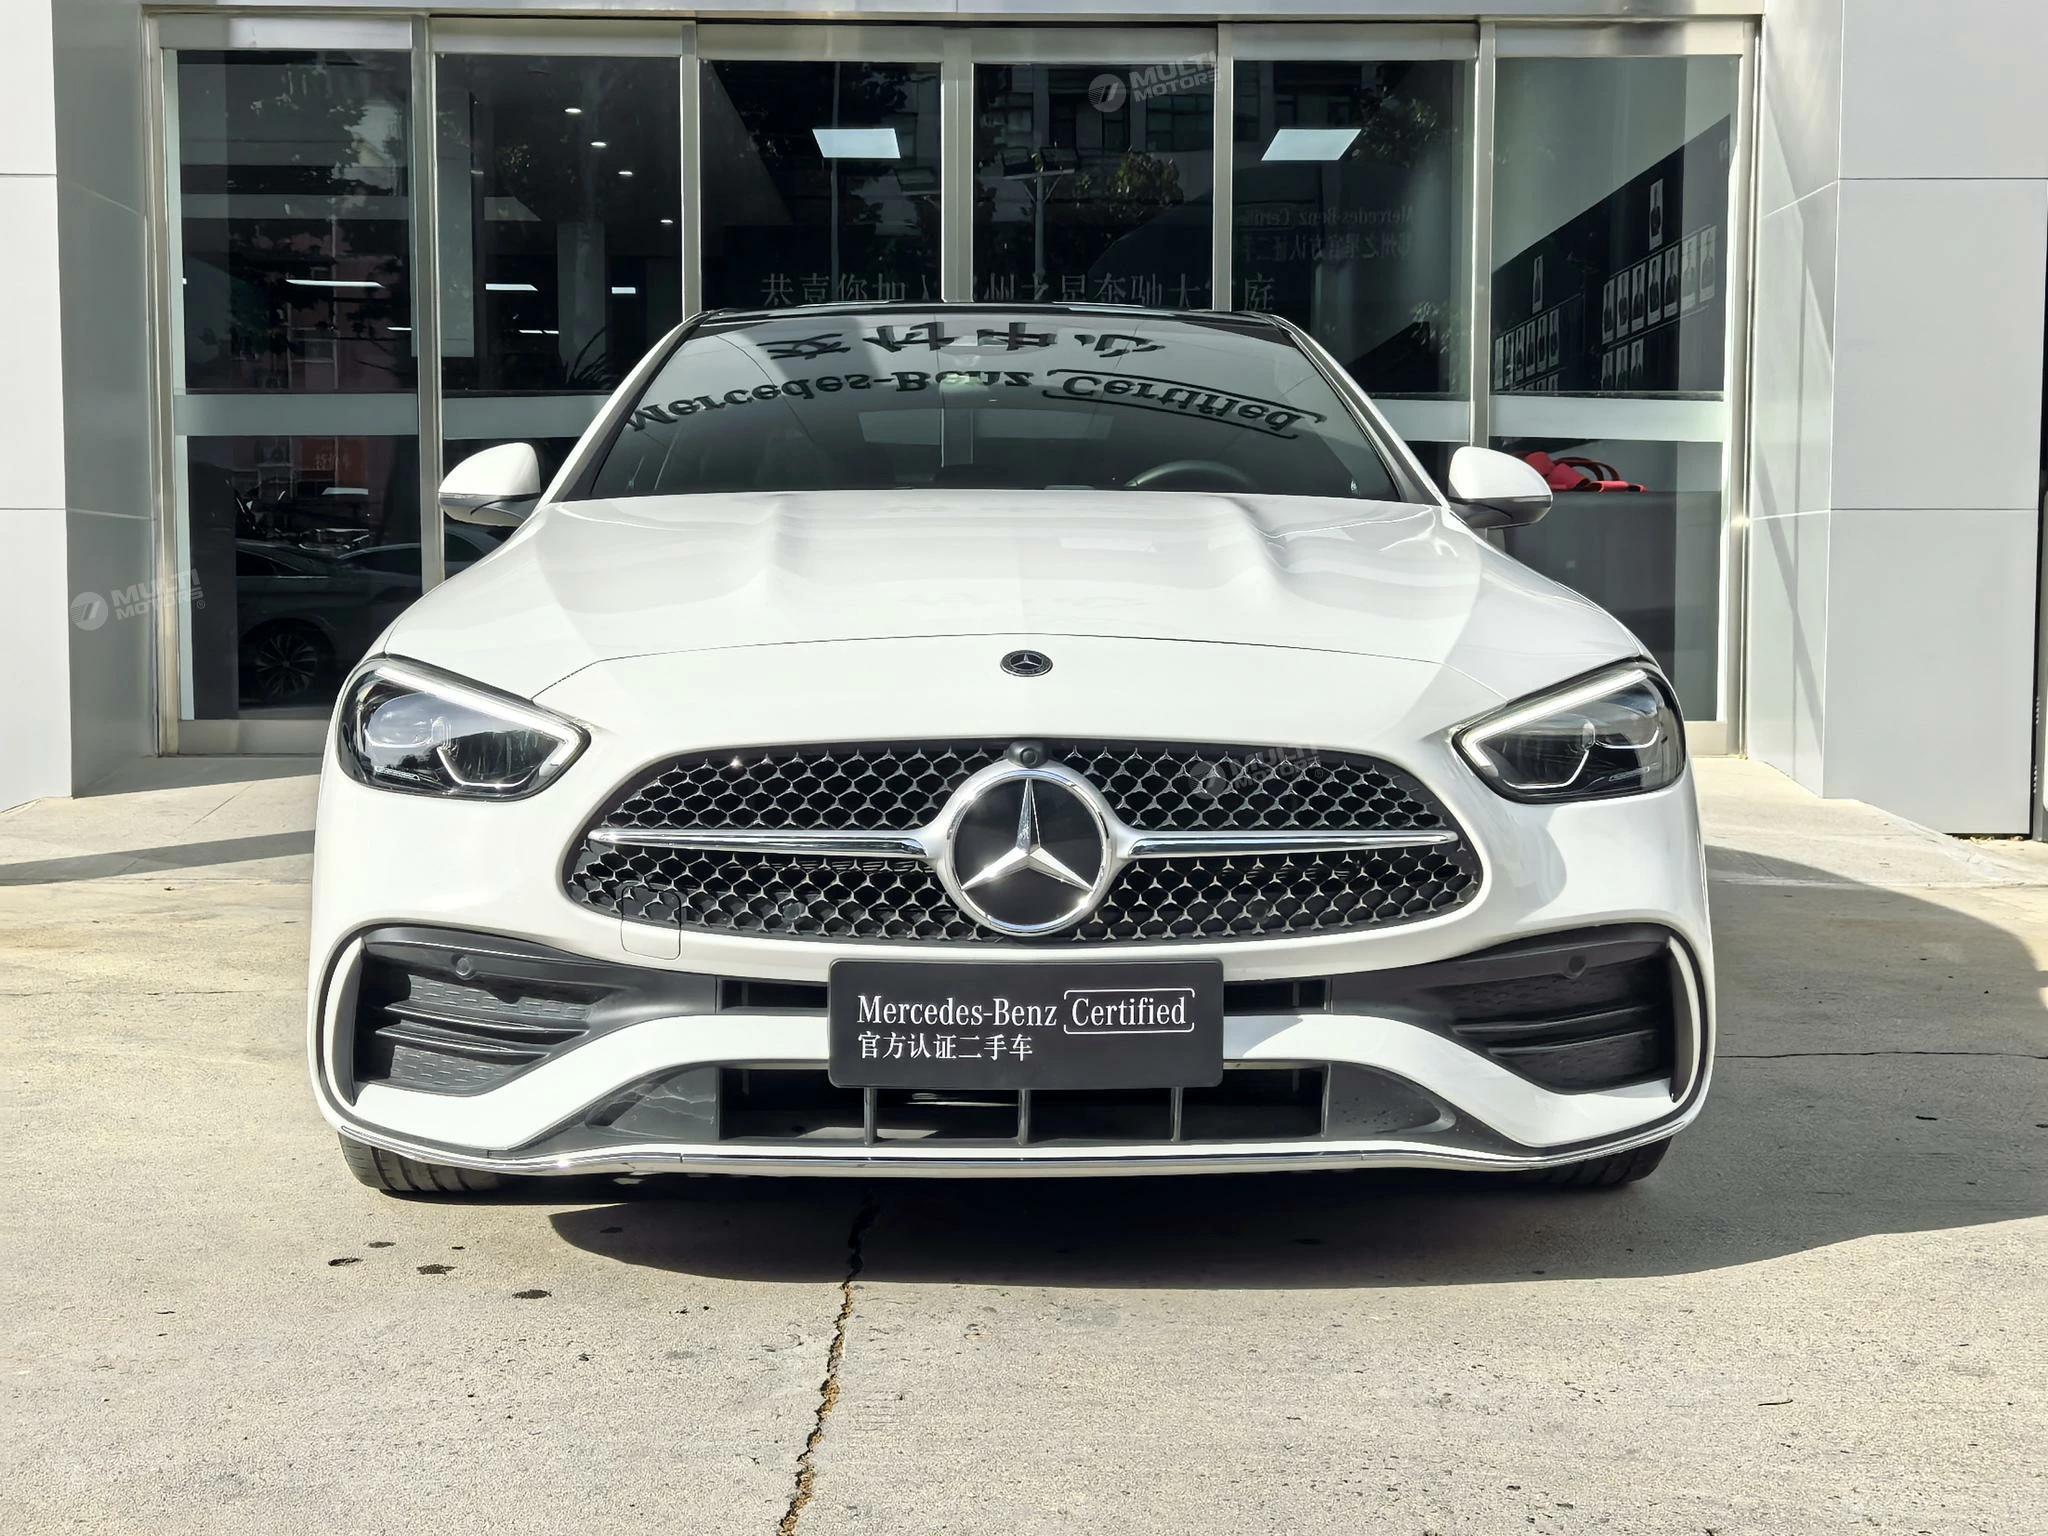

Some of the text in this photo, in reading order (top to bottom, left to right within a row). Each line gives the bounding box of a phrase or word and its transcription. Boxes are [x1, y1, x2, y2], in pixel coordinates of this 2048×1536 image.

[857, 995, 1187, 1026] Mercedes-Benz Certified
[857, 1031, 1033, 1061] 官方认证二手车
